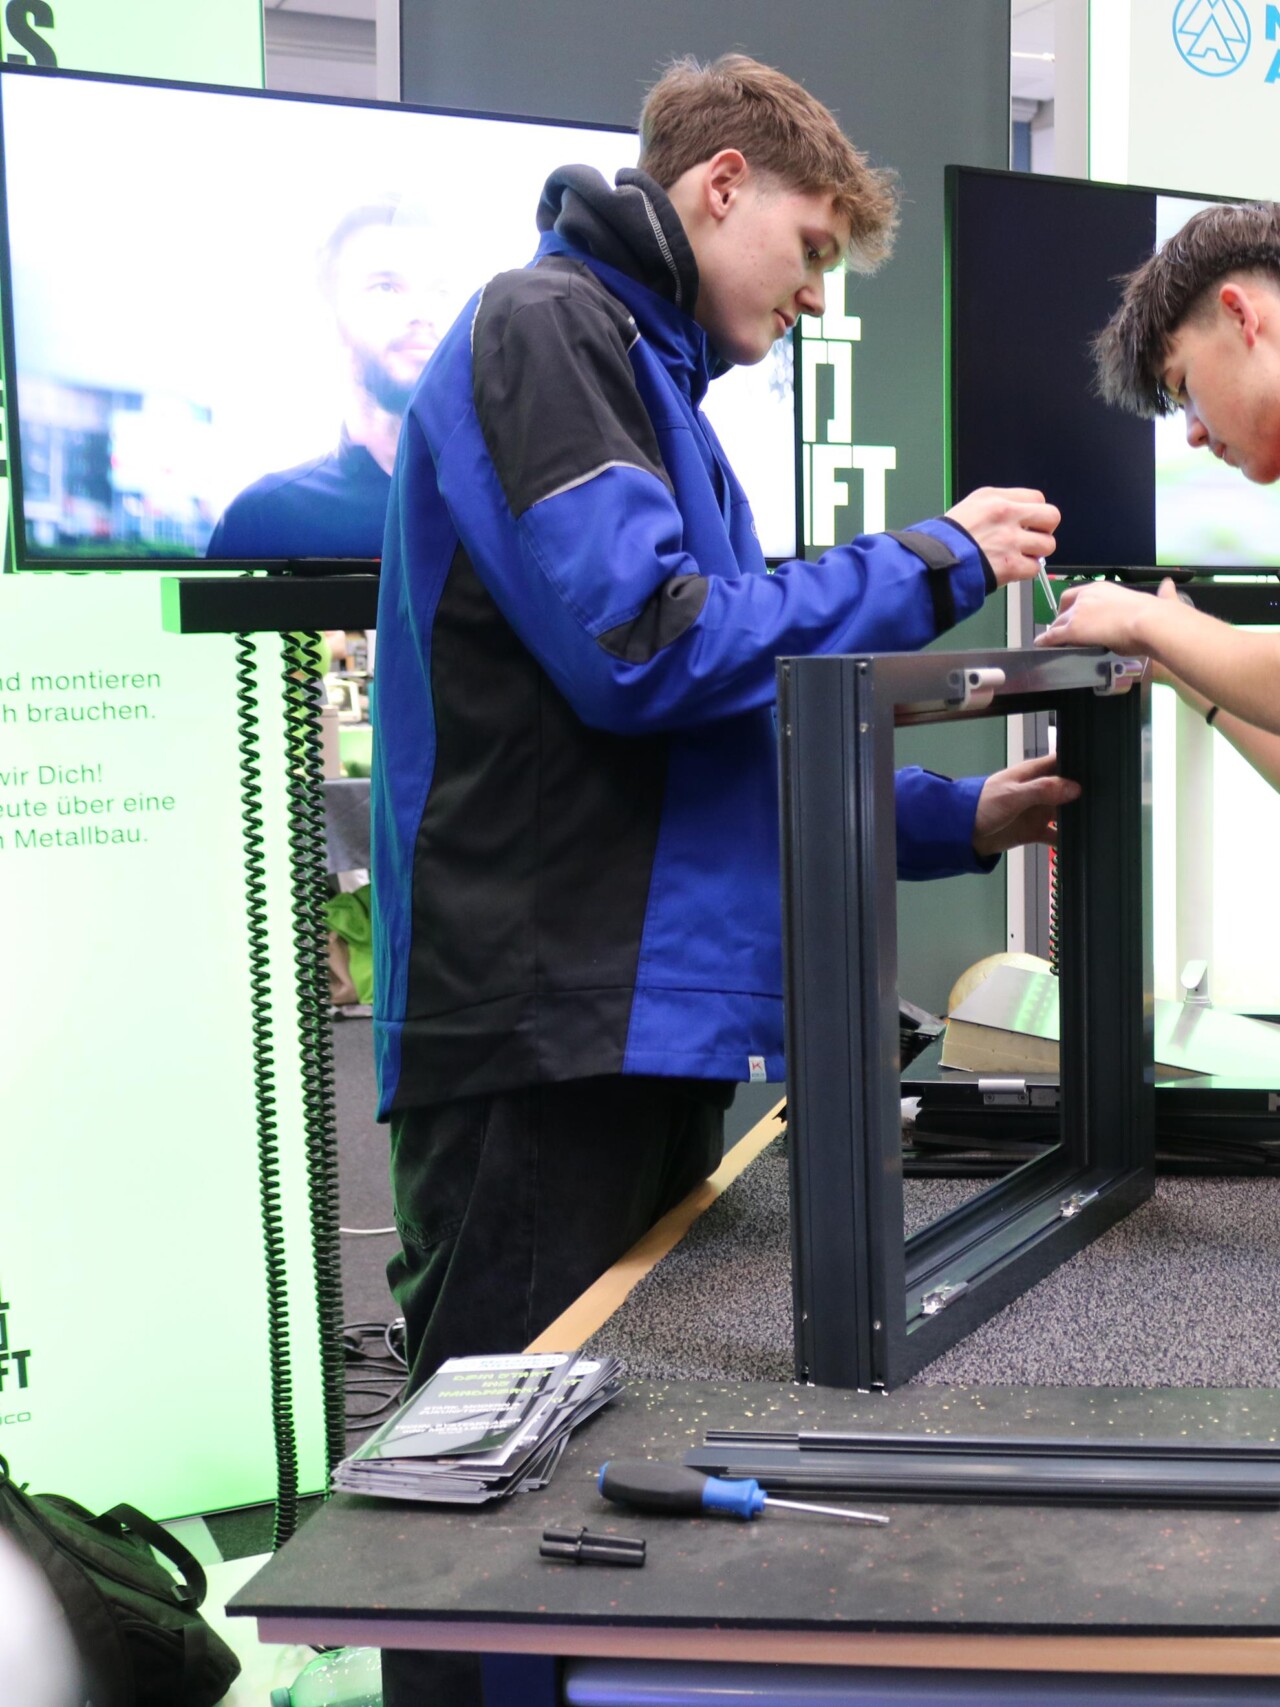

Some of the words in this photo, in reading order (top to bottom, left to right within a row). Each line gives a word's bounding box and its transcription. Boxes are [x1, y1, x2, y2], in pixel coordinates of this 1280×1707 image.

[31, 670, 162, 690] montieren
[27, 701, 156, 723] brauchen.
[38, 763, 103, 786] Dich!
[57, 795, 115, 816] über
[123, 792, 176, 812] eine
[14, 825, 149, 849] Metallbau.
